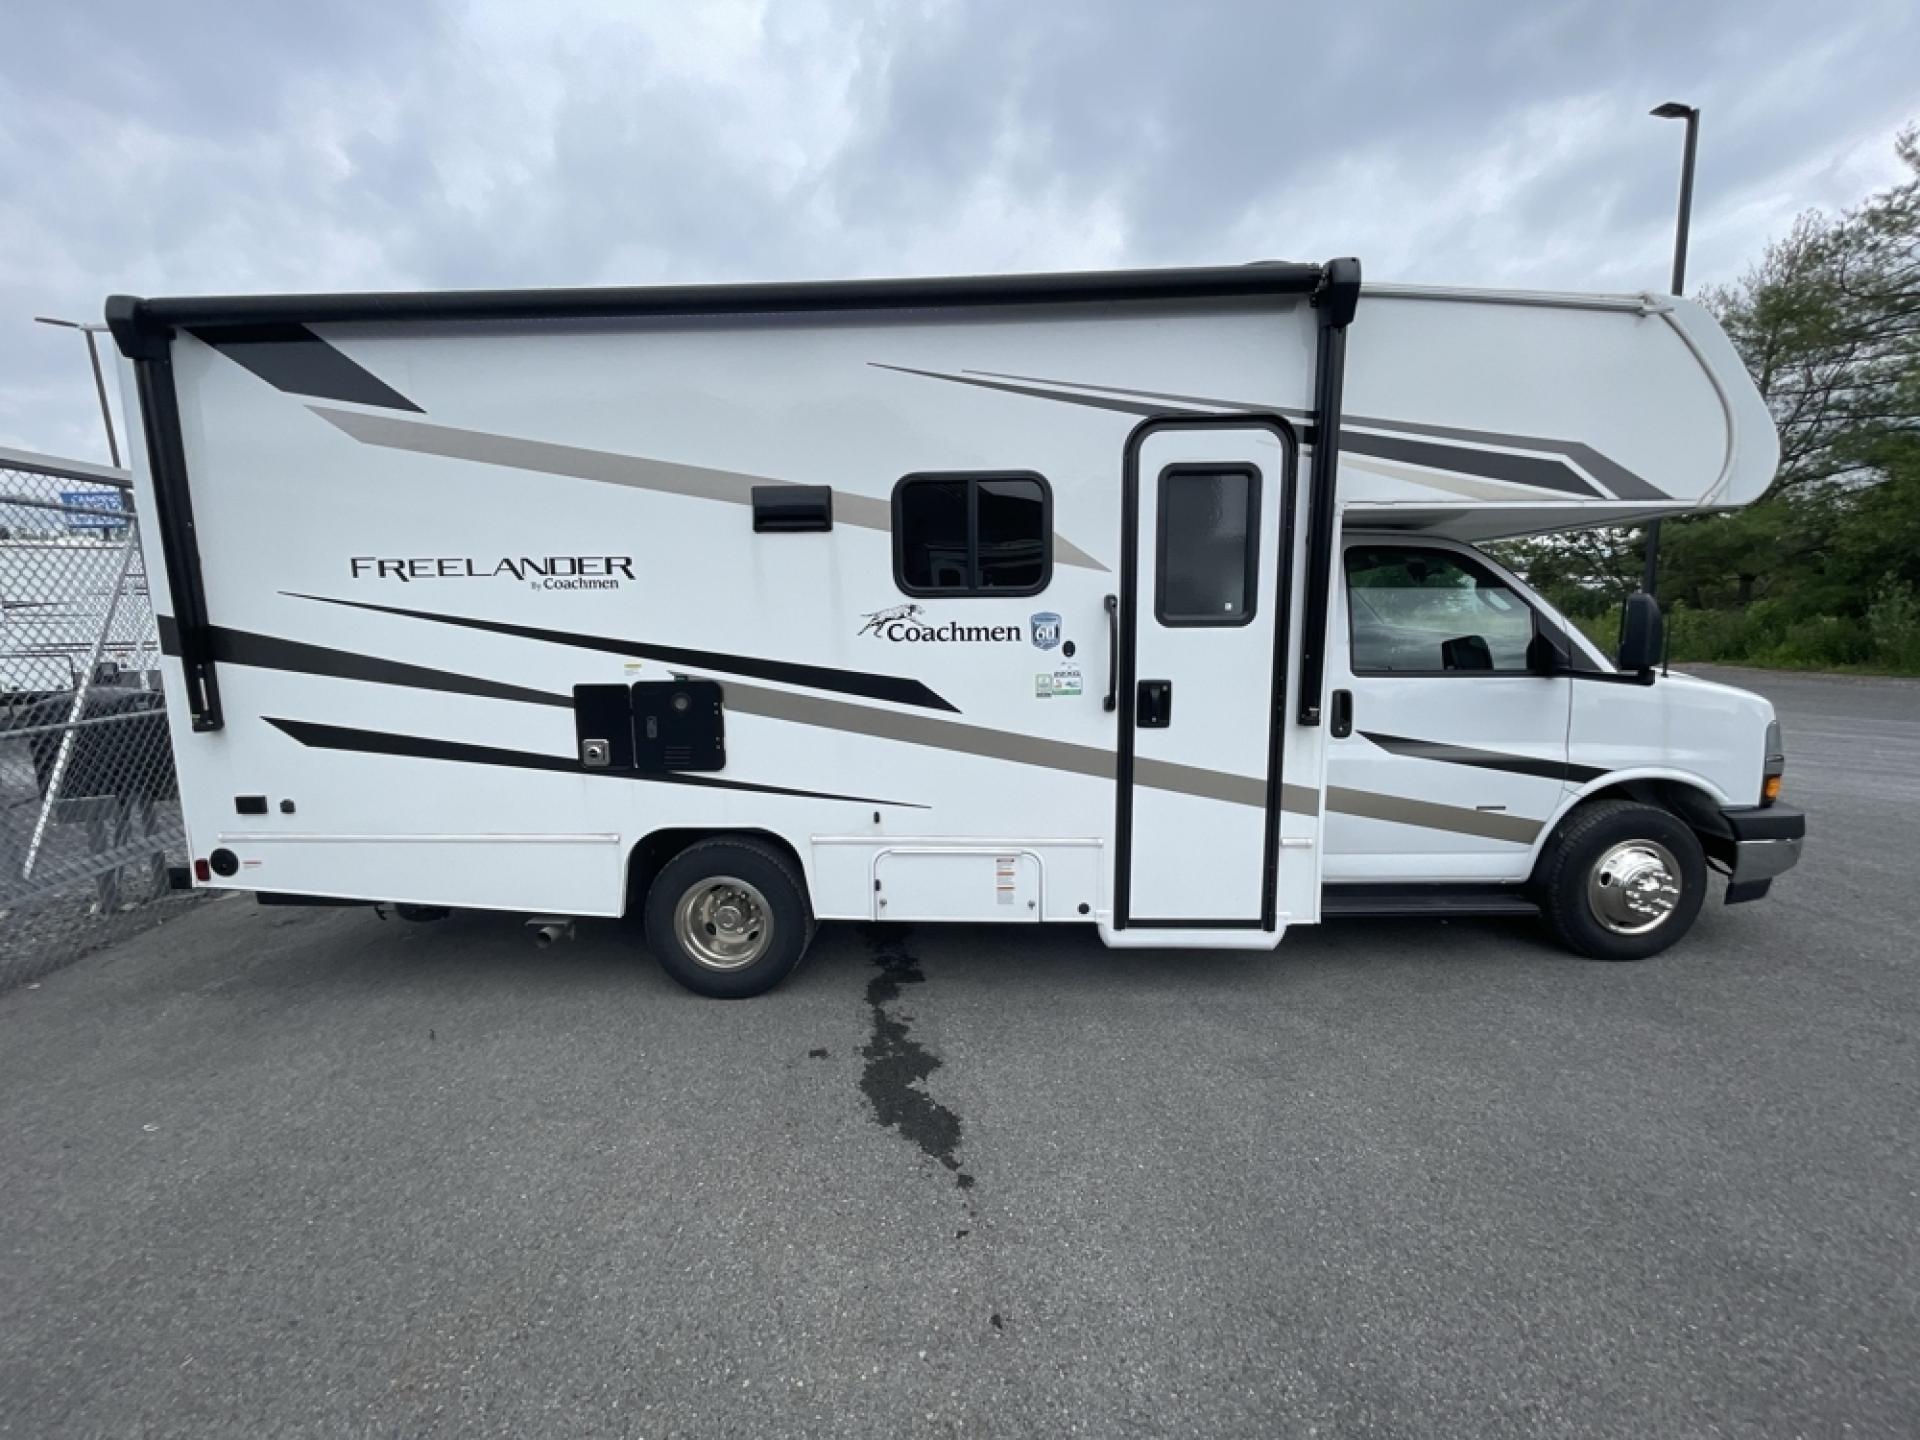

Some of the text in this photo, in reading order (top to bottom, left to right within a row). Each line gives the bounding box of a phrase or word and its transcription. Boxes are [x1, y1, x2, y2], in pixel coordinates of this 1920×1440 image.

[350, 556, 636, 583] FREELANDER
[543, 577, 619, 591] Coachmen
[886, 621, 1022, 642] Coachmen
